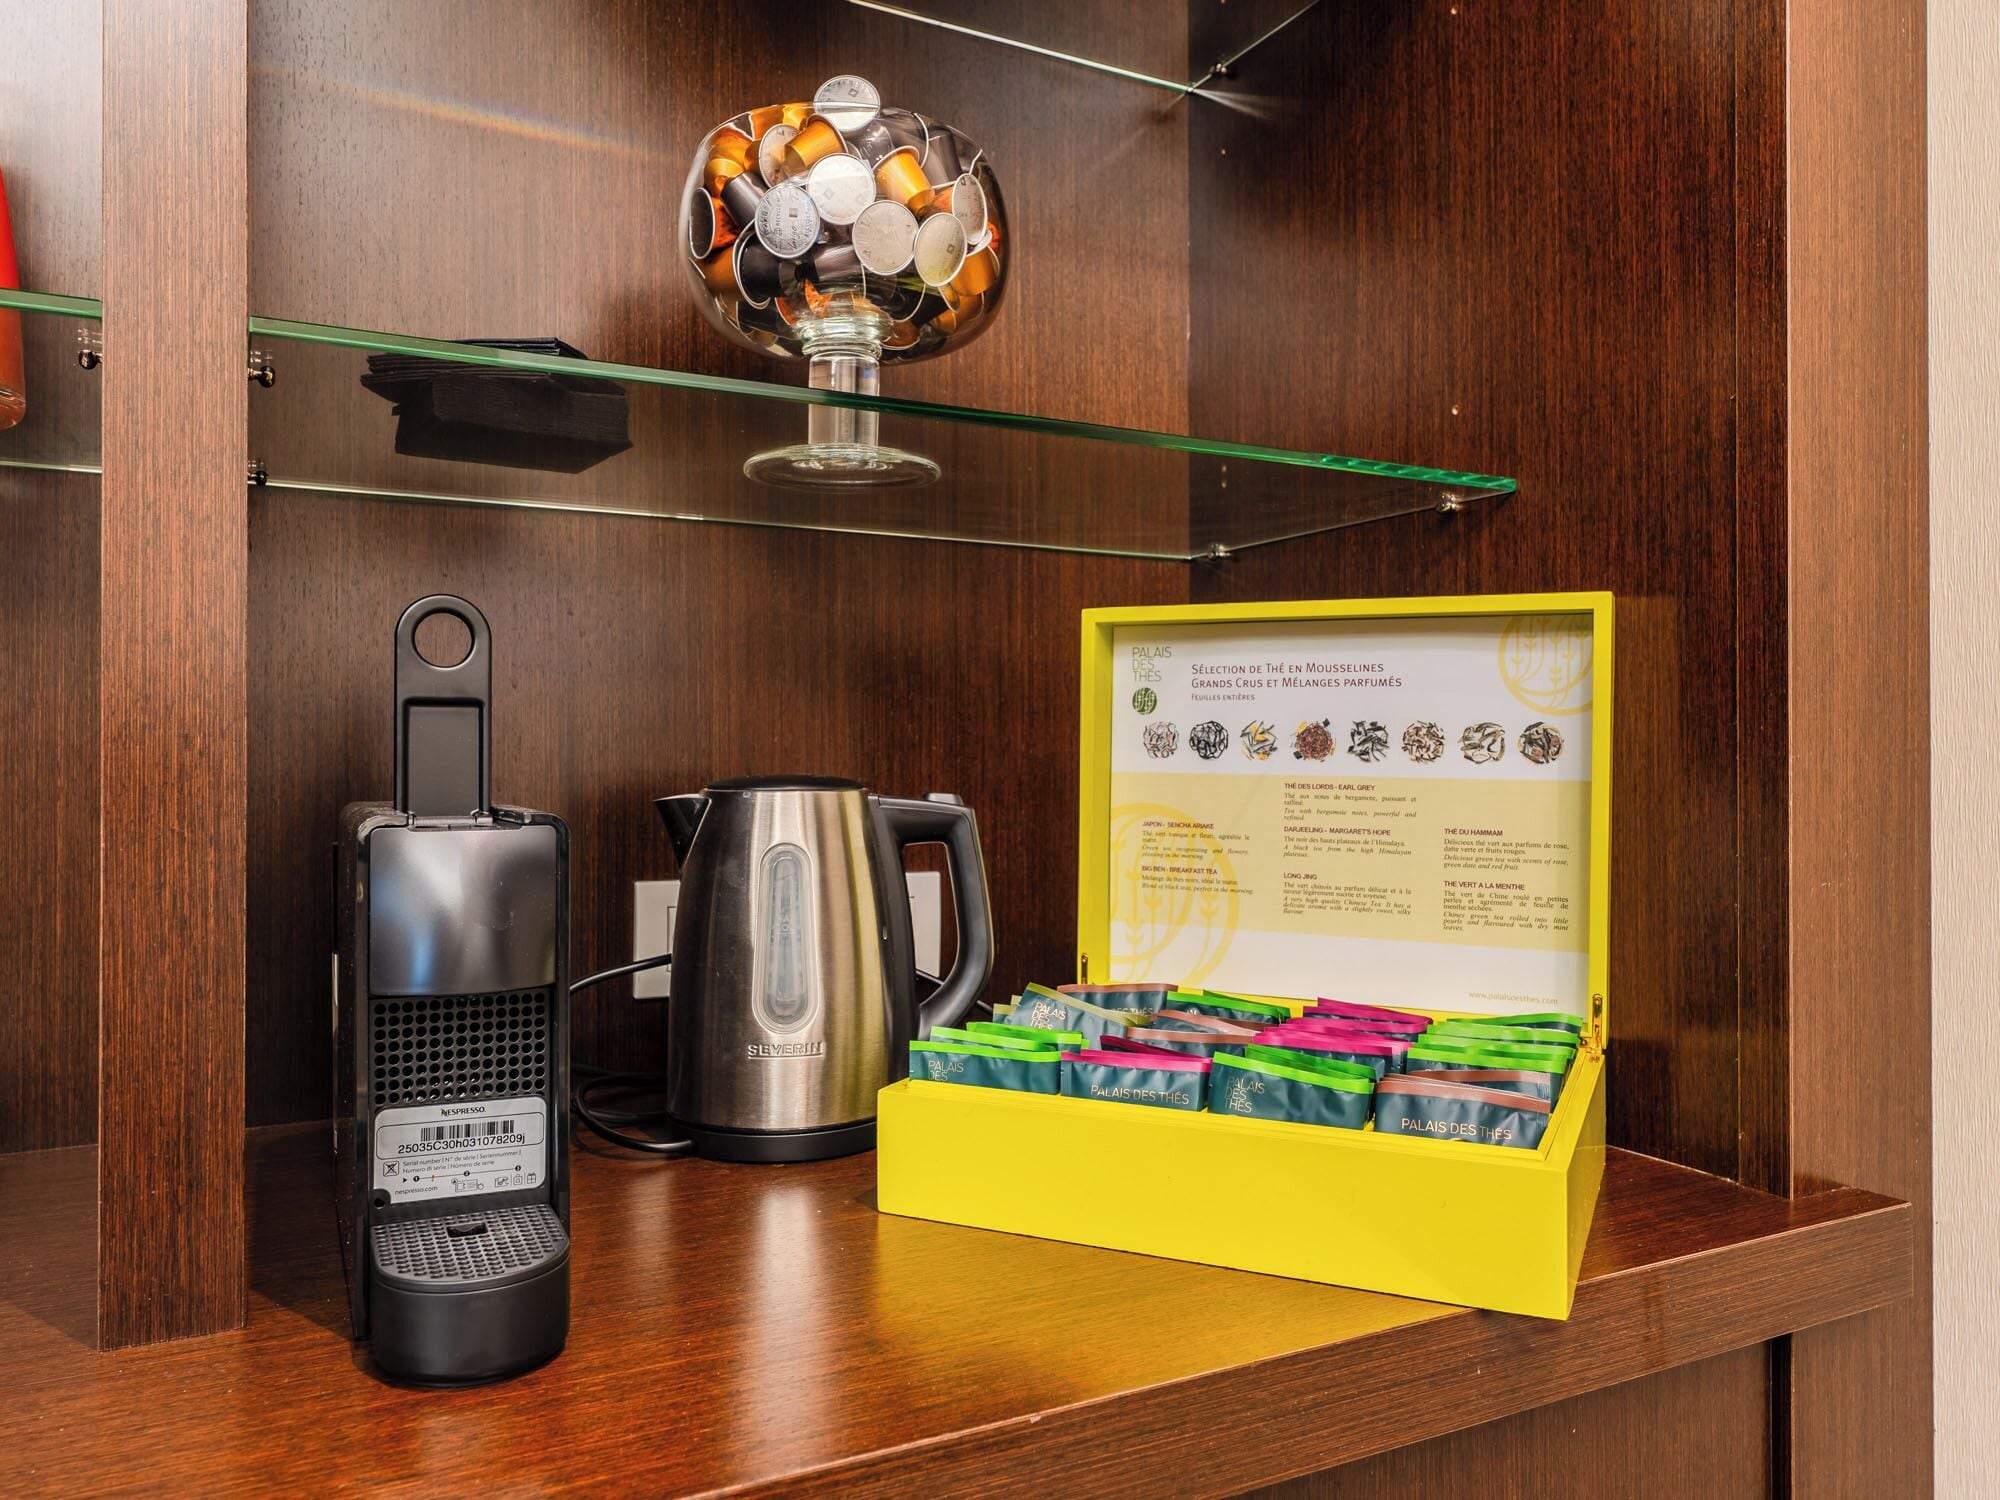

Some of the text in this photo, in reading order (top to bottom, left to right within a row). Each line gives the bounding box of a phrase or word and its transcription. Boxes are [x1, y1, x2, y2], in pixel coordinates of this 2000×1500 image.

[1132, 646, 1172, 658] PALAIS
[1132, 658, 1155, 671] DES
[1031, 1010, 1050, 1023] DES
[1034, 1001, 1067, 1020] PALAIS
[748, 1041, 824, 1056] SEVERIN
[928, 1060, 964, 1073] PALAIS
[1227, 1077, 1265, 1094] PALAIS
[1091, 1084, 1189, 1104] PALAIS DES THÉS
[1225, 1087, 1247, 1100] DES
[1401, 1118, 1512, 1140] PALAIS DES THÉS
[398, 1133, 525, 1154] 25035C30h031078209j
[395, 1186, 438, 1196] nespresso.com
